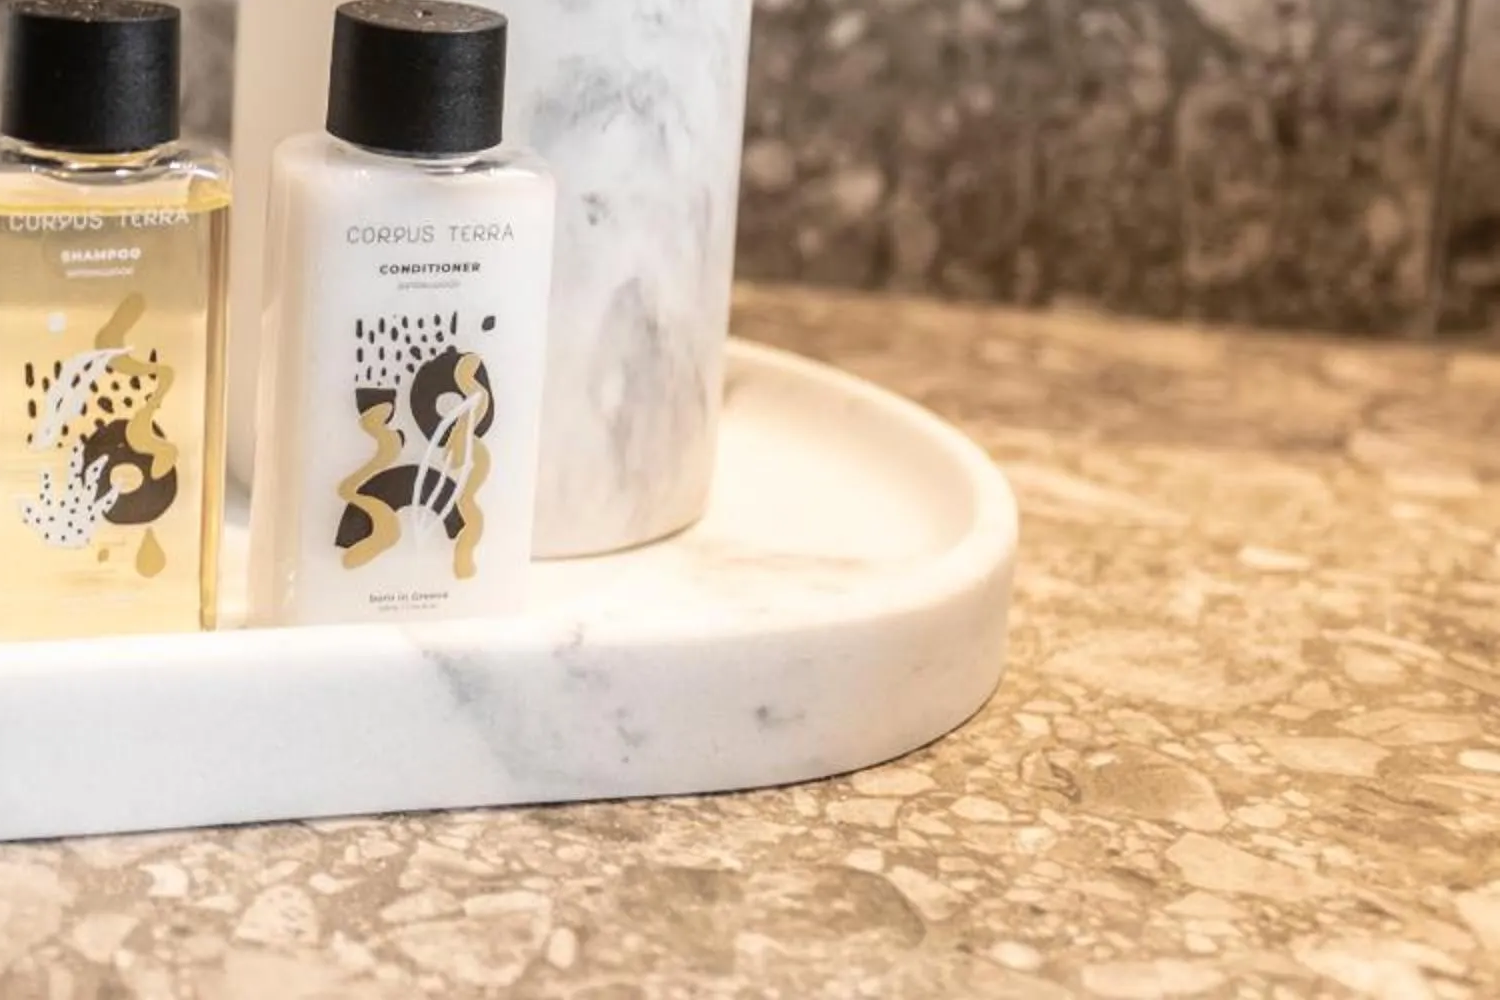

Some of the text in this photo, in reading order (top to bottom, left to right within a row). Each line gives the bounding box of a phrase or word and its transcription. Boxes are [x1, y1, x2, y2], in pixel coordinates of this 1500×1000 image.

[8, 206, 190, 231] CORPUS TERRA
[345, 222, 515, 245] CORPUS TERRA
[60, 247, 142, 263] SHAMPOO
[379, 261, 482, 275] CONDITIONER
